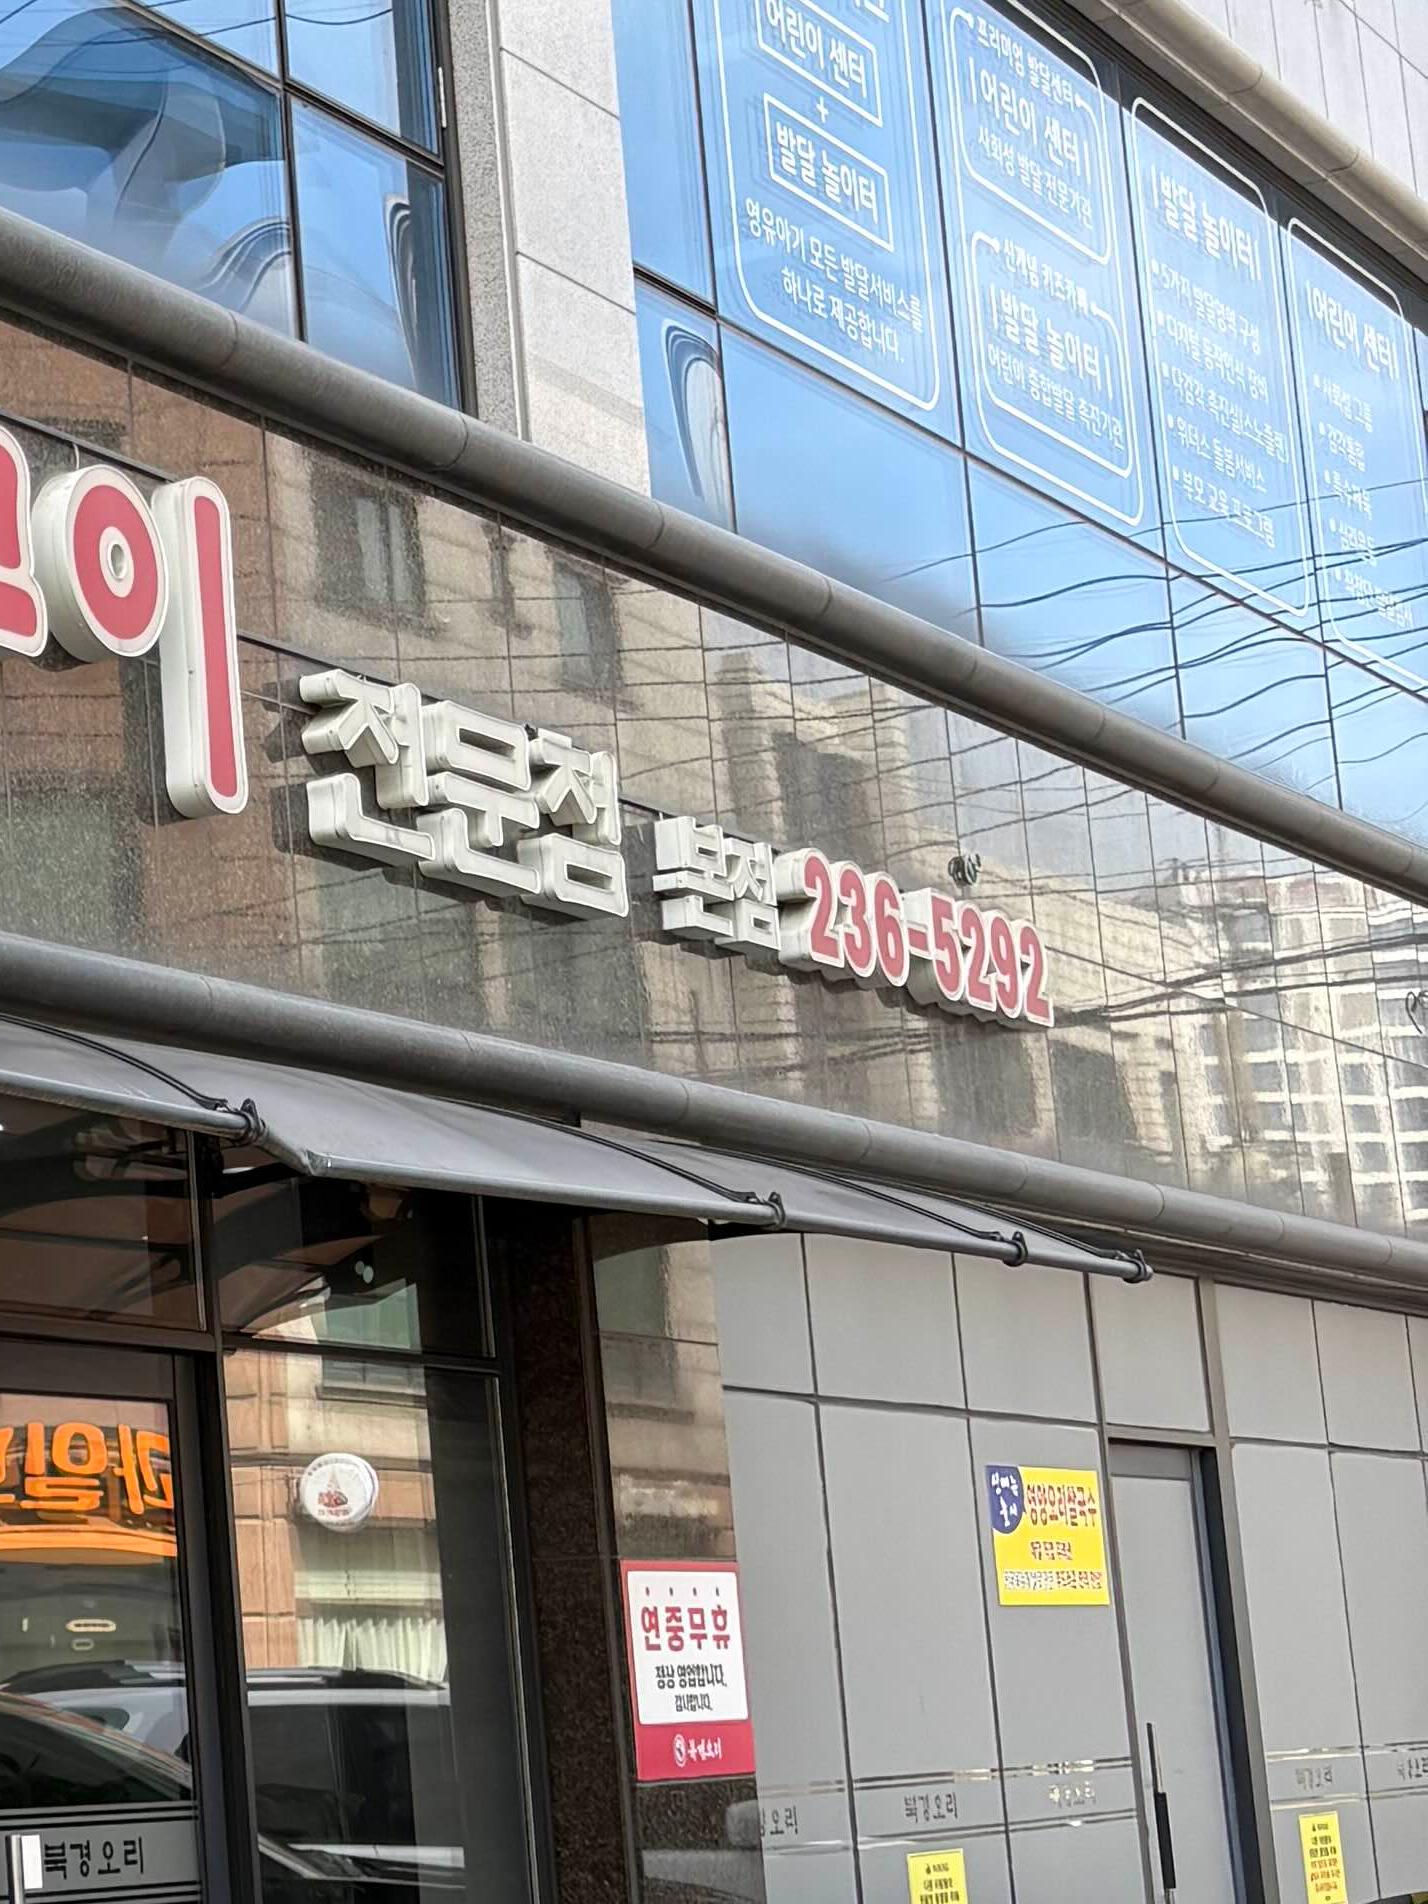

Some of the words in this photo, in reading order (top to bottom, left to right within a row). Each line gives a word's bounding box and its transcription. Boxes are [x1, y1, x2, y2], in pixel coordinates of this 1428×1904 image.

[828, 37, 867, 99] 센터
[976, 14, 1025, 79] 프리미엄
[979, 68, 1038, 145] 어린이
[1044, 114, 1081, 177] 센터
[775, 121, 817, 188] 발달
[821, 148, 879, 225] 놀이터
[745, 197, 807, 264] 영유아기
[809, 237, 840, 284] 모든
[841, 254, 925, 334] 발달서비스를
[1160, 170, 1198, 245] 발달
[1201, 199, 1256, 282] 놀이터
[781, 265, 829, 321] 하나로
[999, 288, 1040, 357] 발달
[1046, 317, 1102, 392] 놀이터
[1312, 286, 1361, 357] 어린이
[1362, 323, 1396, 383] 센터
[299, 667, 629, 919] 전문점
[651, 814, 782, 952] 본점
[780, 847, 1056, 1029] 236-5292
[640, 1604, 732, 1653] 연중무휴
[43, 1834, 145, 1880] 북경오리
